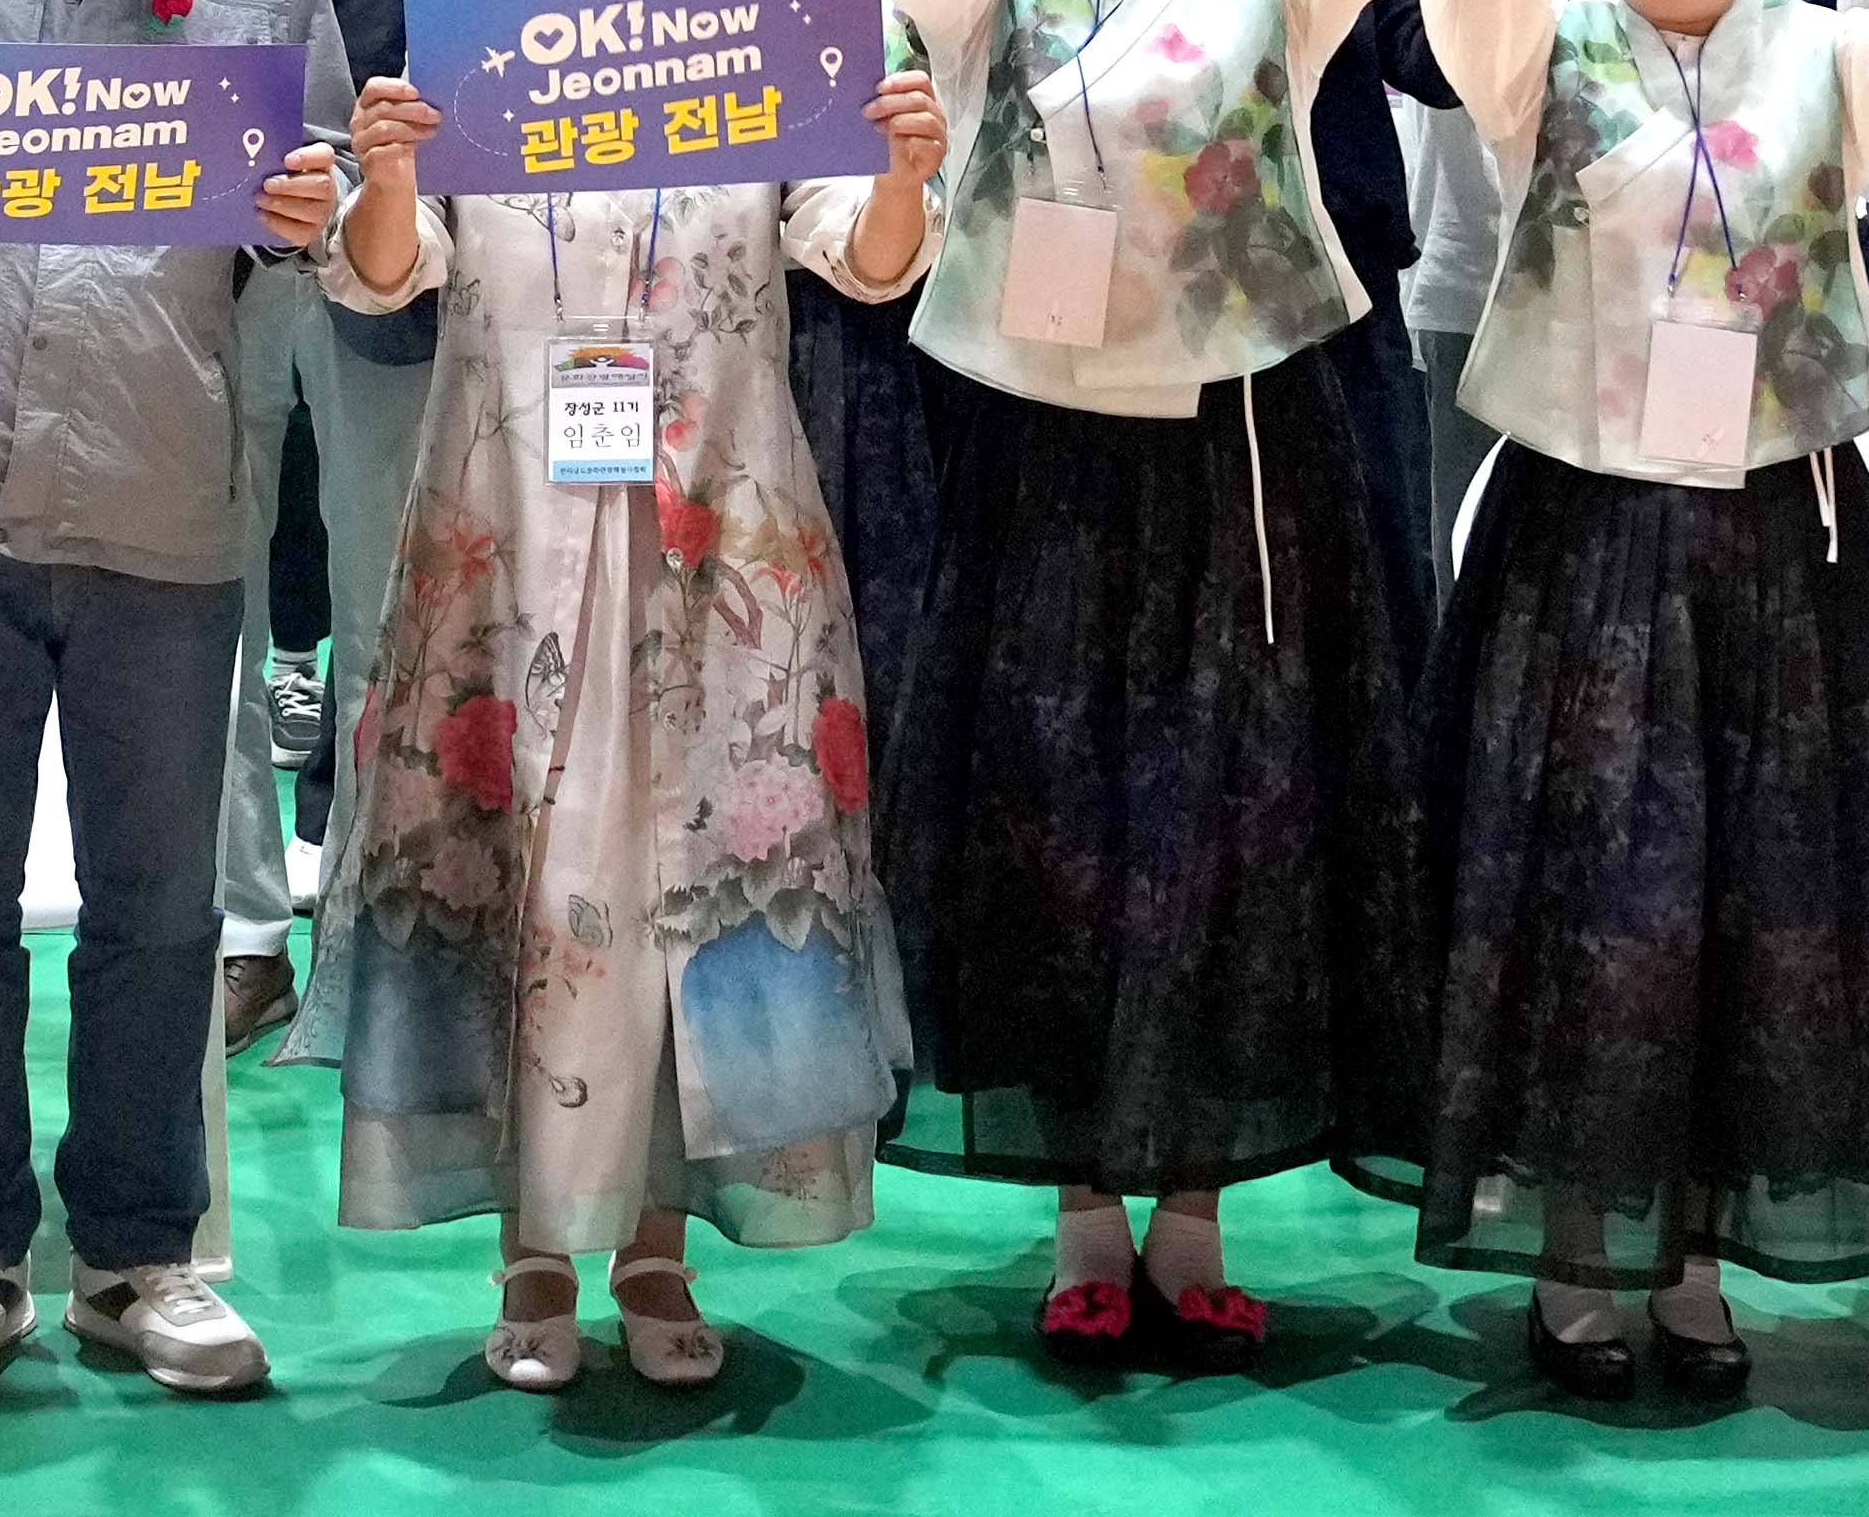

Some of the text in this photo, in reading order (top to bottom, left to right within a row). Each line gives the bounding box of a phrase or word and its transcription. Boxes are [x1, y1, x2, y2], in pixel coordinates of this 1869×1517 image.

[521, 0, 758, 64] OK! Now
[86, 78, 191, 111] Now
[529, 46, 761, 104] Jeonnam
[521, 86, 782, 173] 관광 전남
[84, 160, 201, 213] 전남
[564, 401, 639, 416] 장성군 11기
